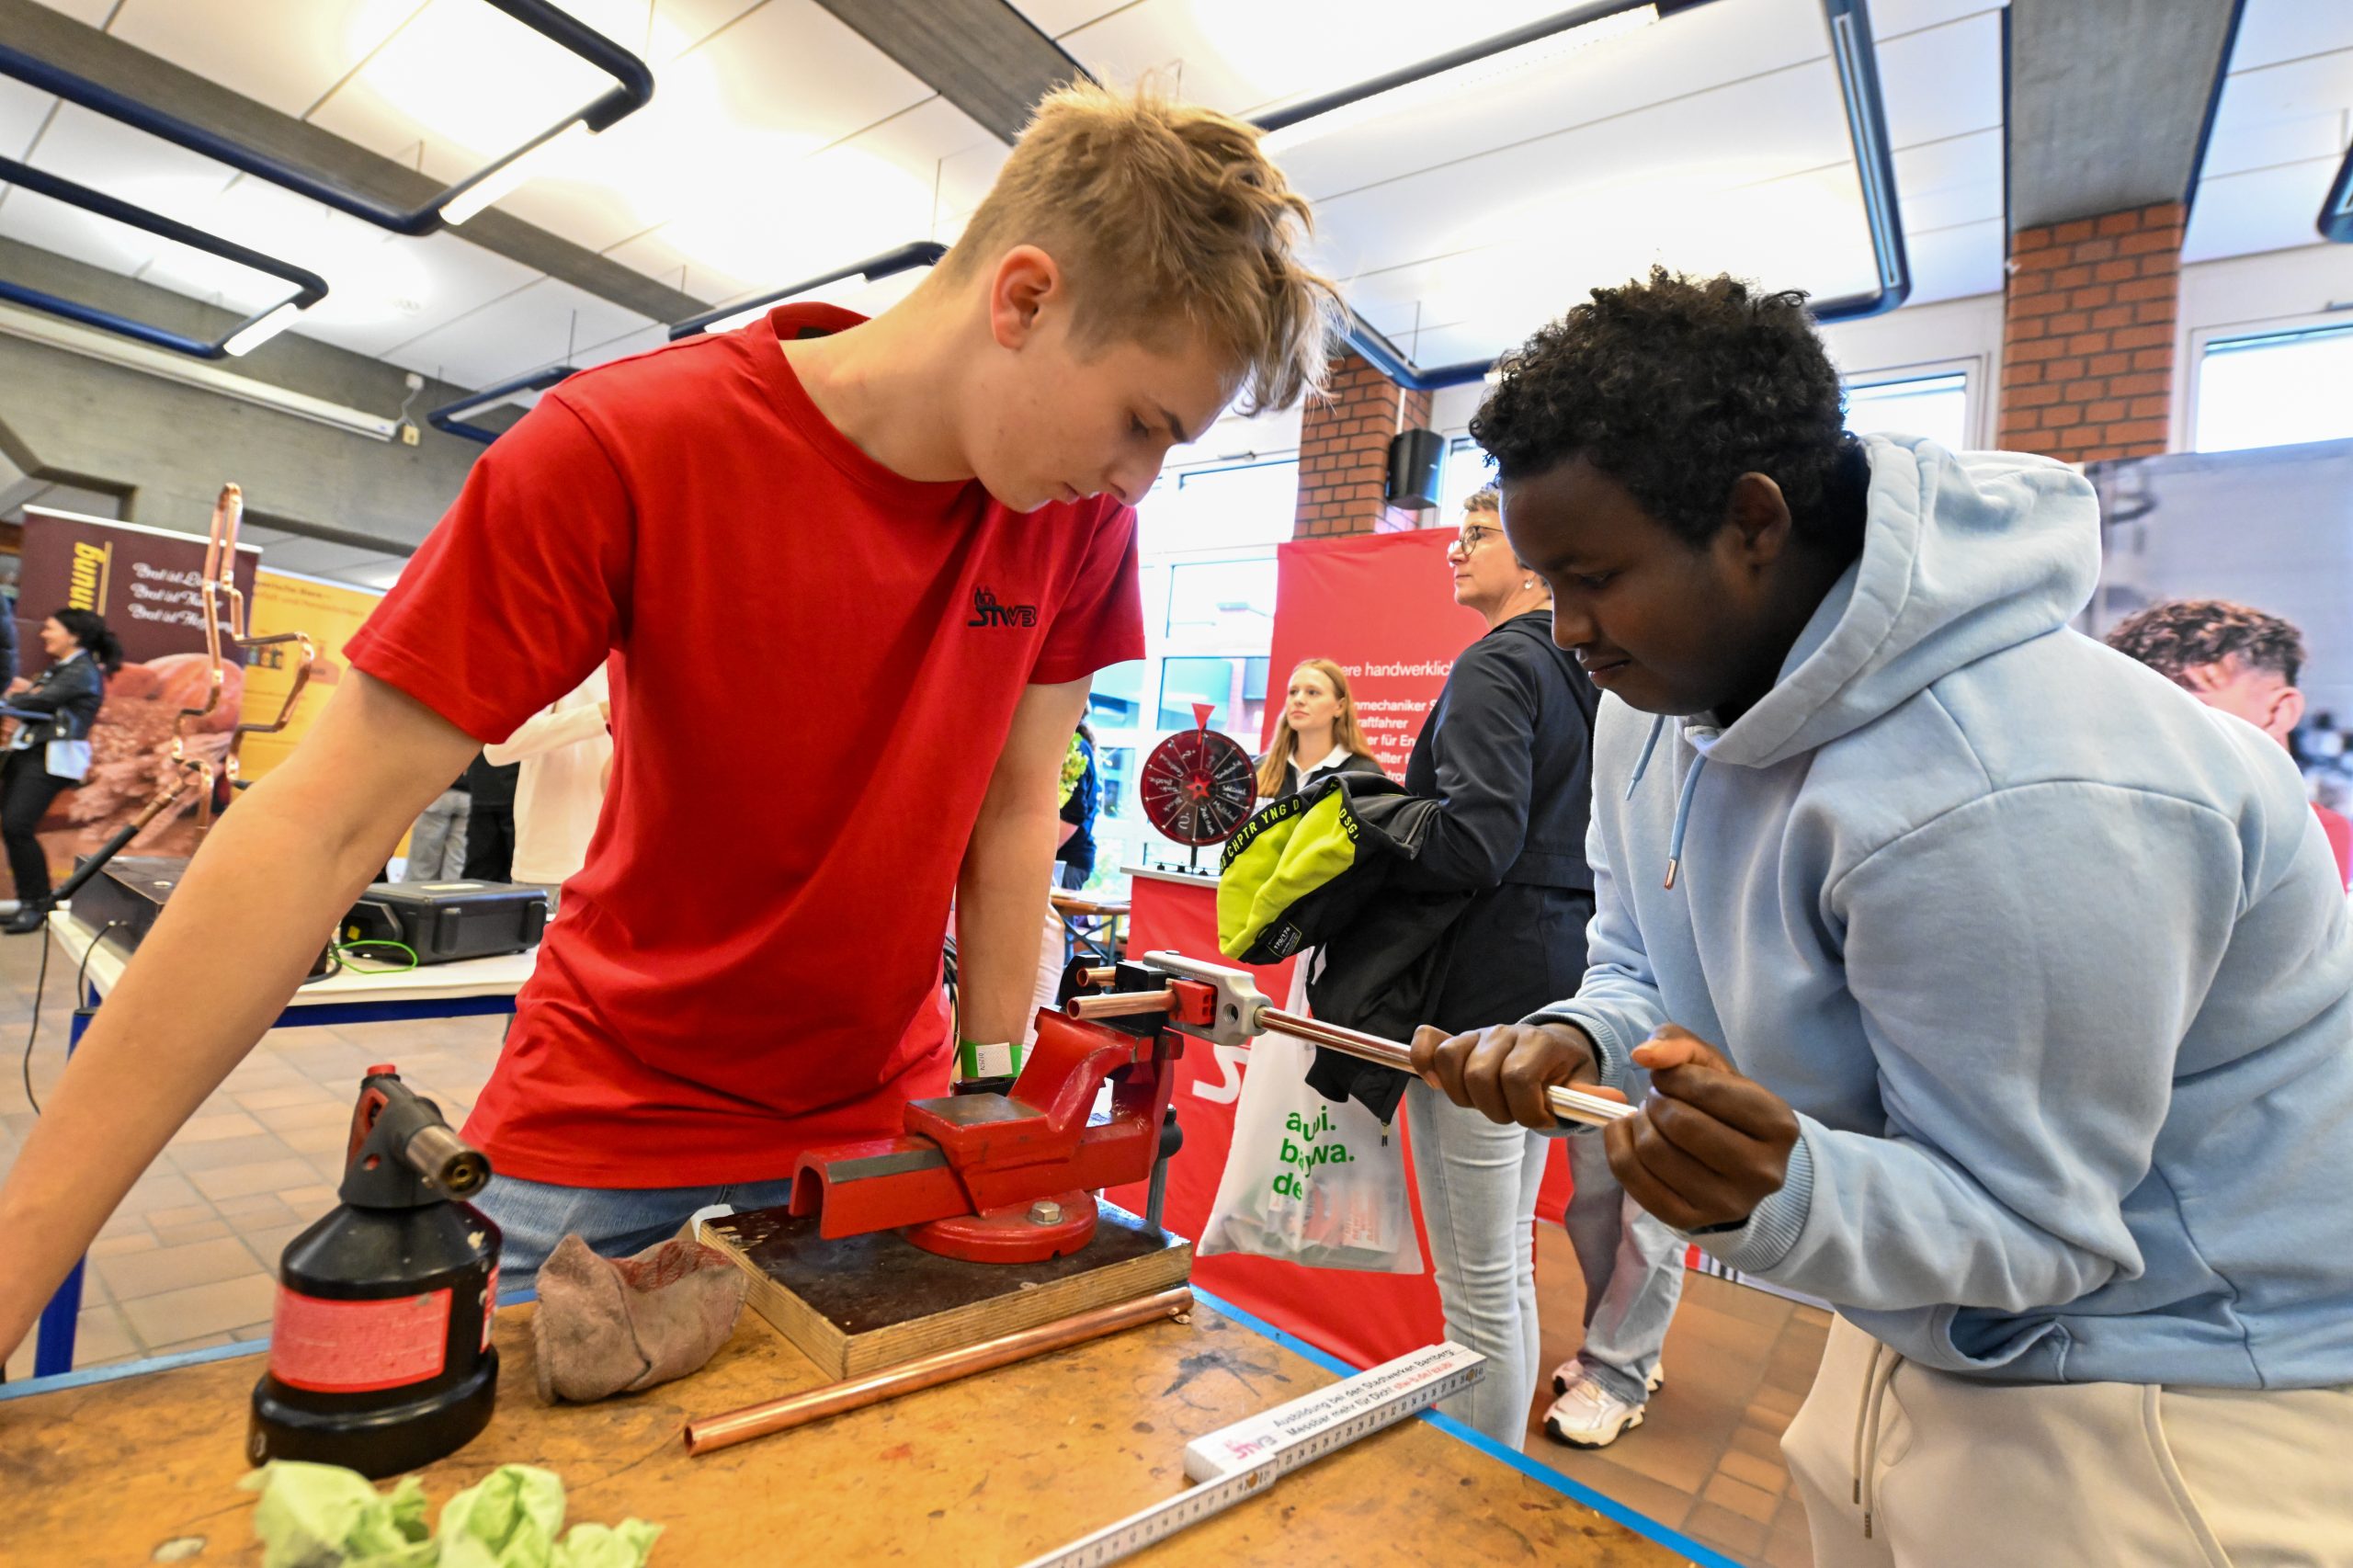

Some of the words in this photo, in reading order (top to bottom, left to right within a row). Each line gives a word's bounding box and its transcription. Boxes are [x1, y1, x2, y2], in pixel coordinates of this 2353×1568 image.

[1381, 734, 1397, 746] für
[1227, 821, 1257, 858] CHPTR
[1261, 803, 1287, 824] YNG
